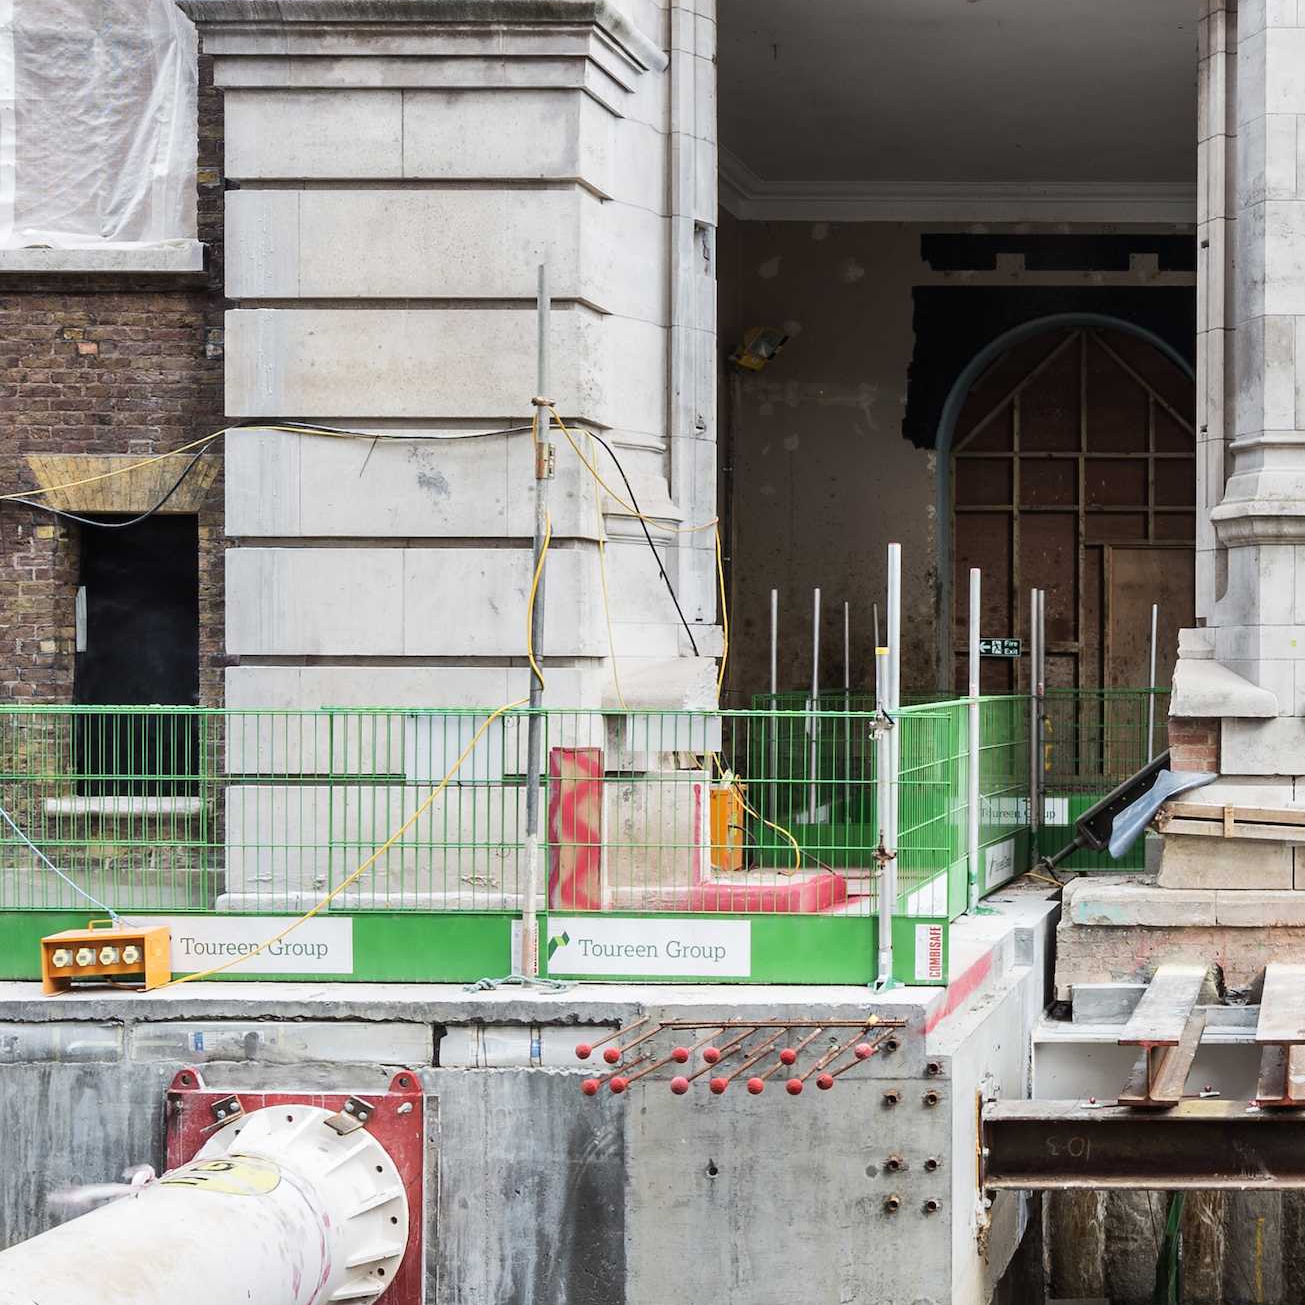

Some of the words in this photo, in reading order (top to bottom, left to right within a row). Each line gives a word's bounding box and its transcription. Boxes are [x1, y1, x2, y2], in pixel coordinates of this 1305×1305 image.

[1004, 647, 1018, 655] Exit
[180, 937, 260, 956] Toureen
[267, 937, 329, 959] Group
[578, 939, 659, 958] Toureen
[665, 940, 727, 962] Group
[929, 926, 942, 978] COMBISAFE
